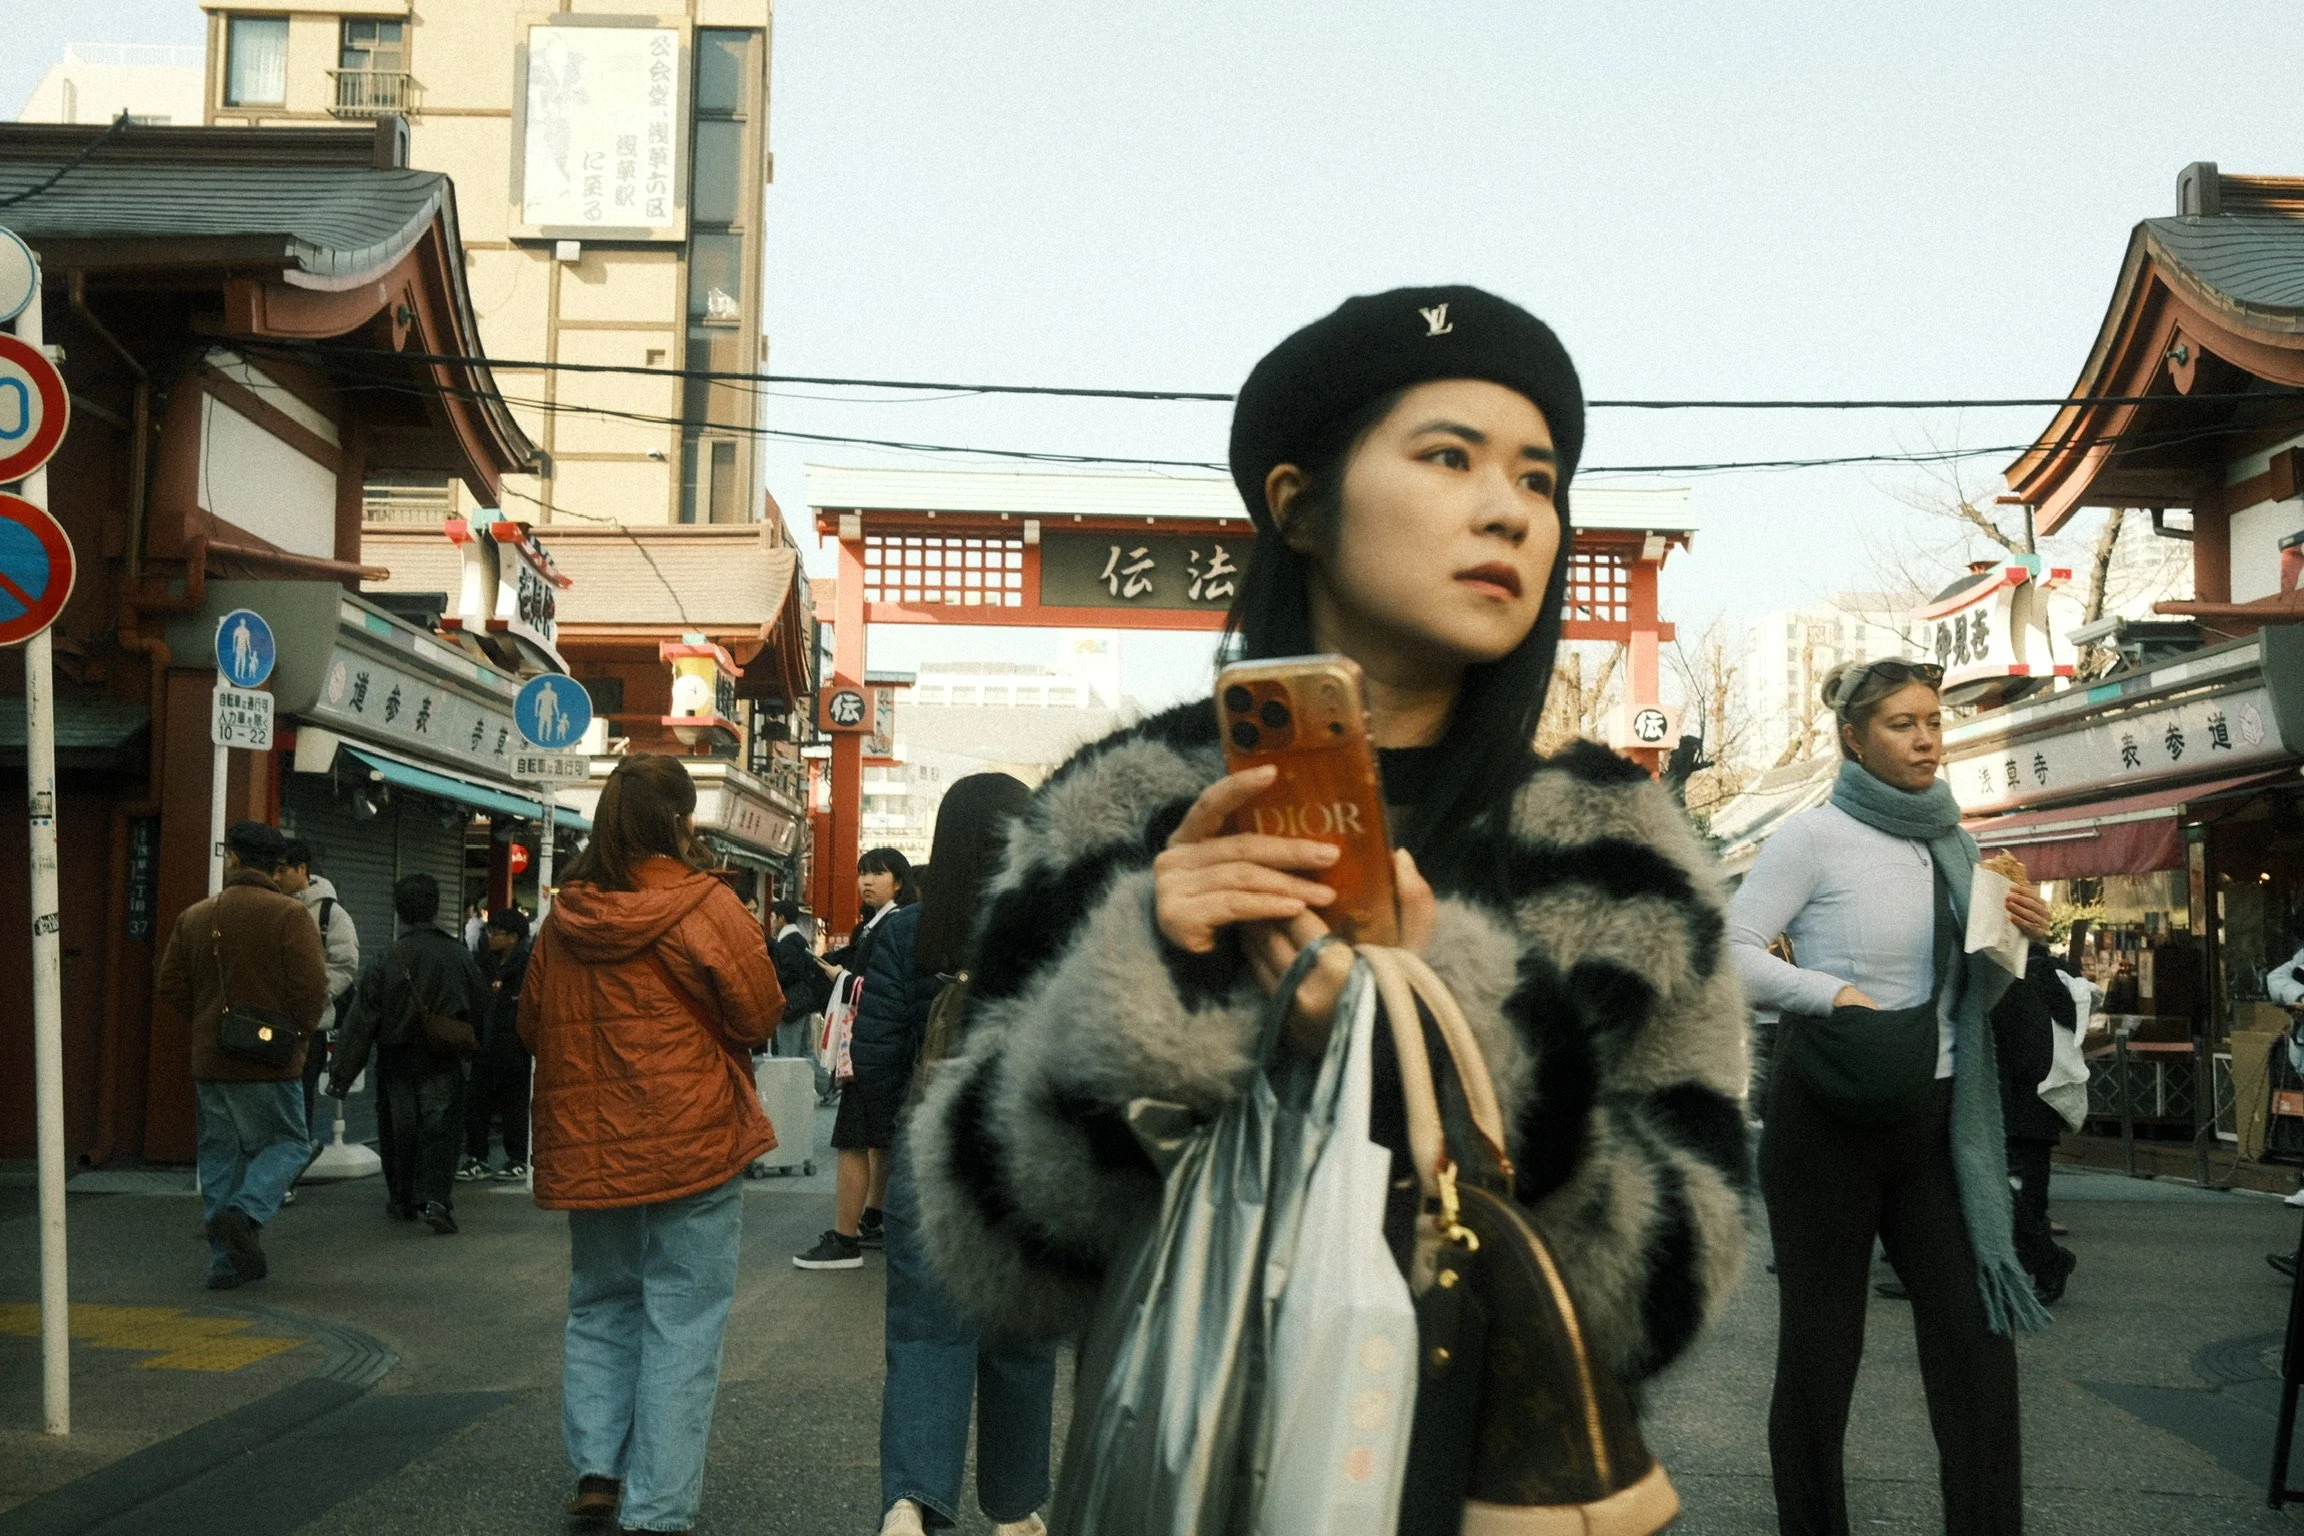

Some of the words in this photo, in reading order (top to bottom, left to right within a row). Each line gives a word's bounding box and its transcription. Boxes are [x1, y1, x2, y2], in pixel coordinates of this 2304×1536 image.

[582, 151, 606, 221] に至る
[1100, 544, 1238, 600] 伝法
[1977, 750, 2050, 795] 浅草寺
[2120, 711, 2233, 769] 表参道
[1251, 801, 1366, 837] DIOR
